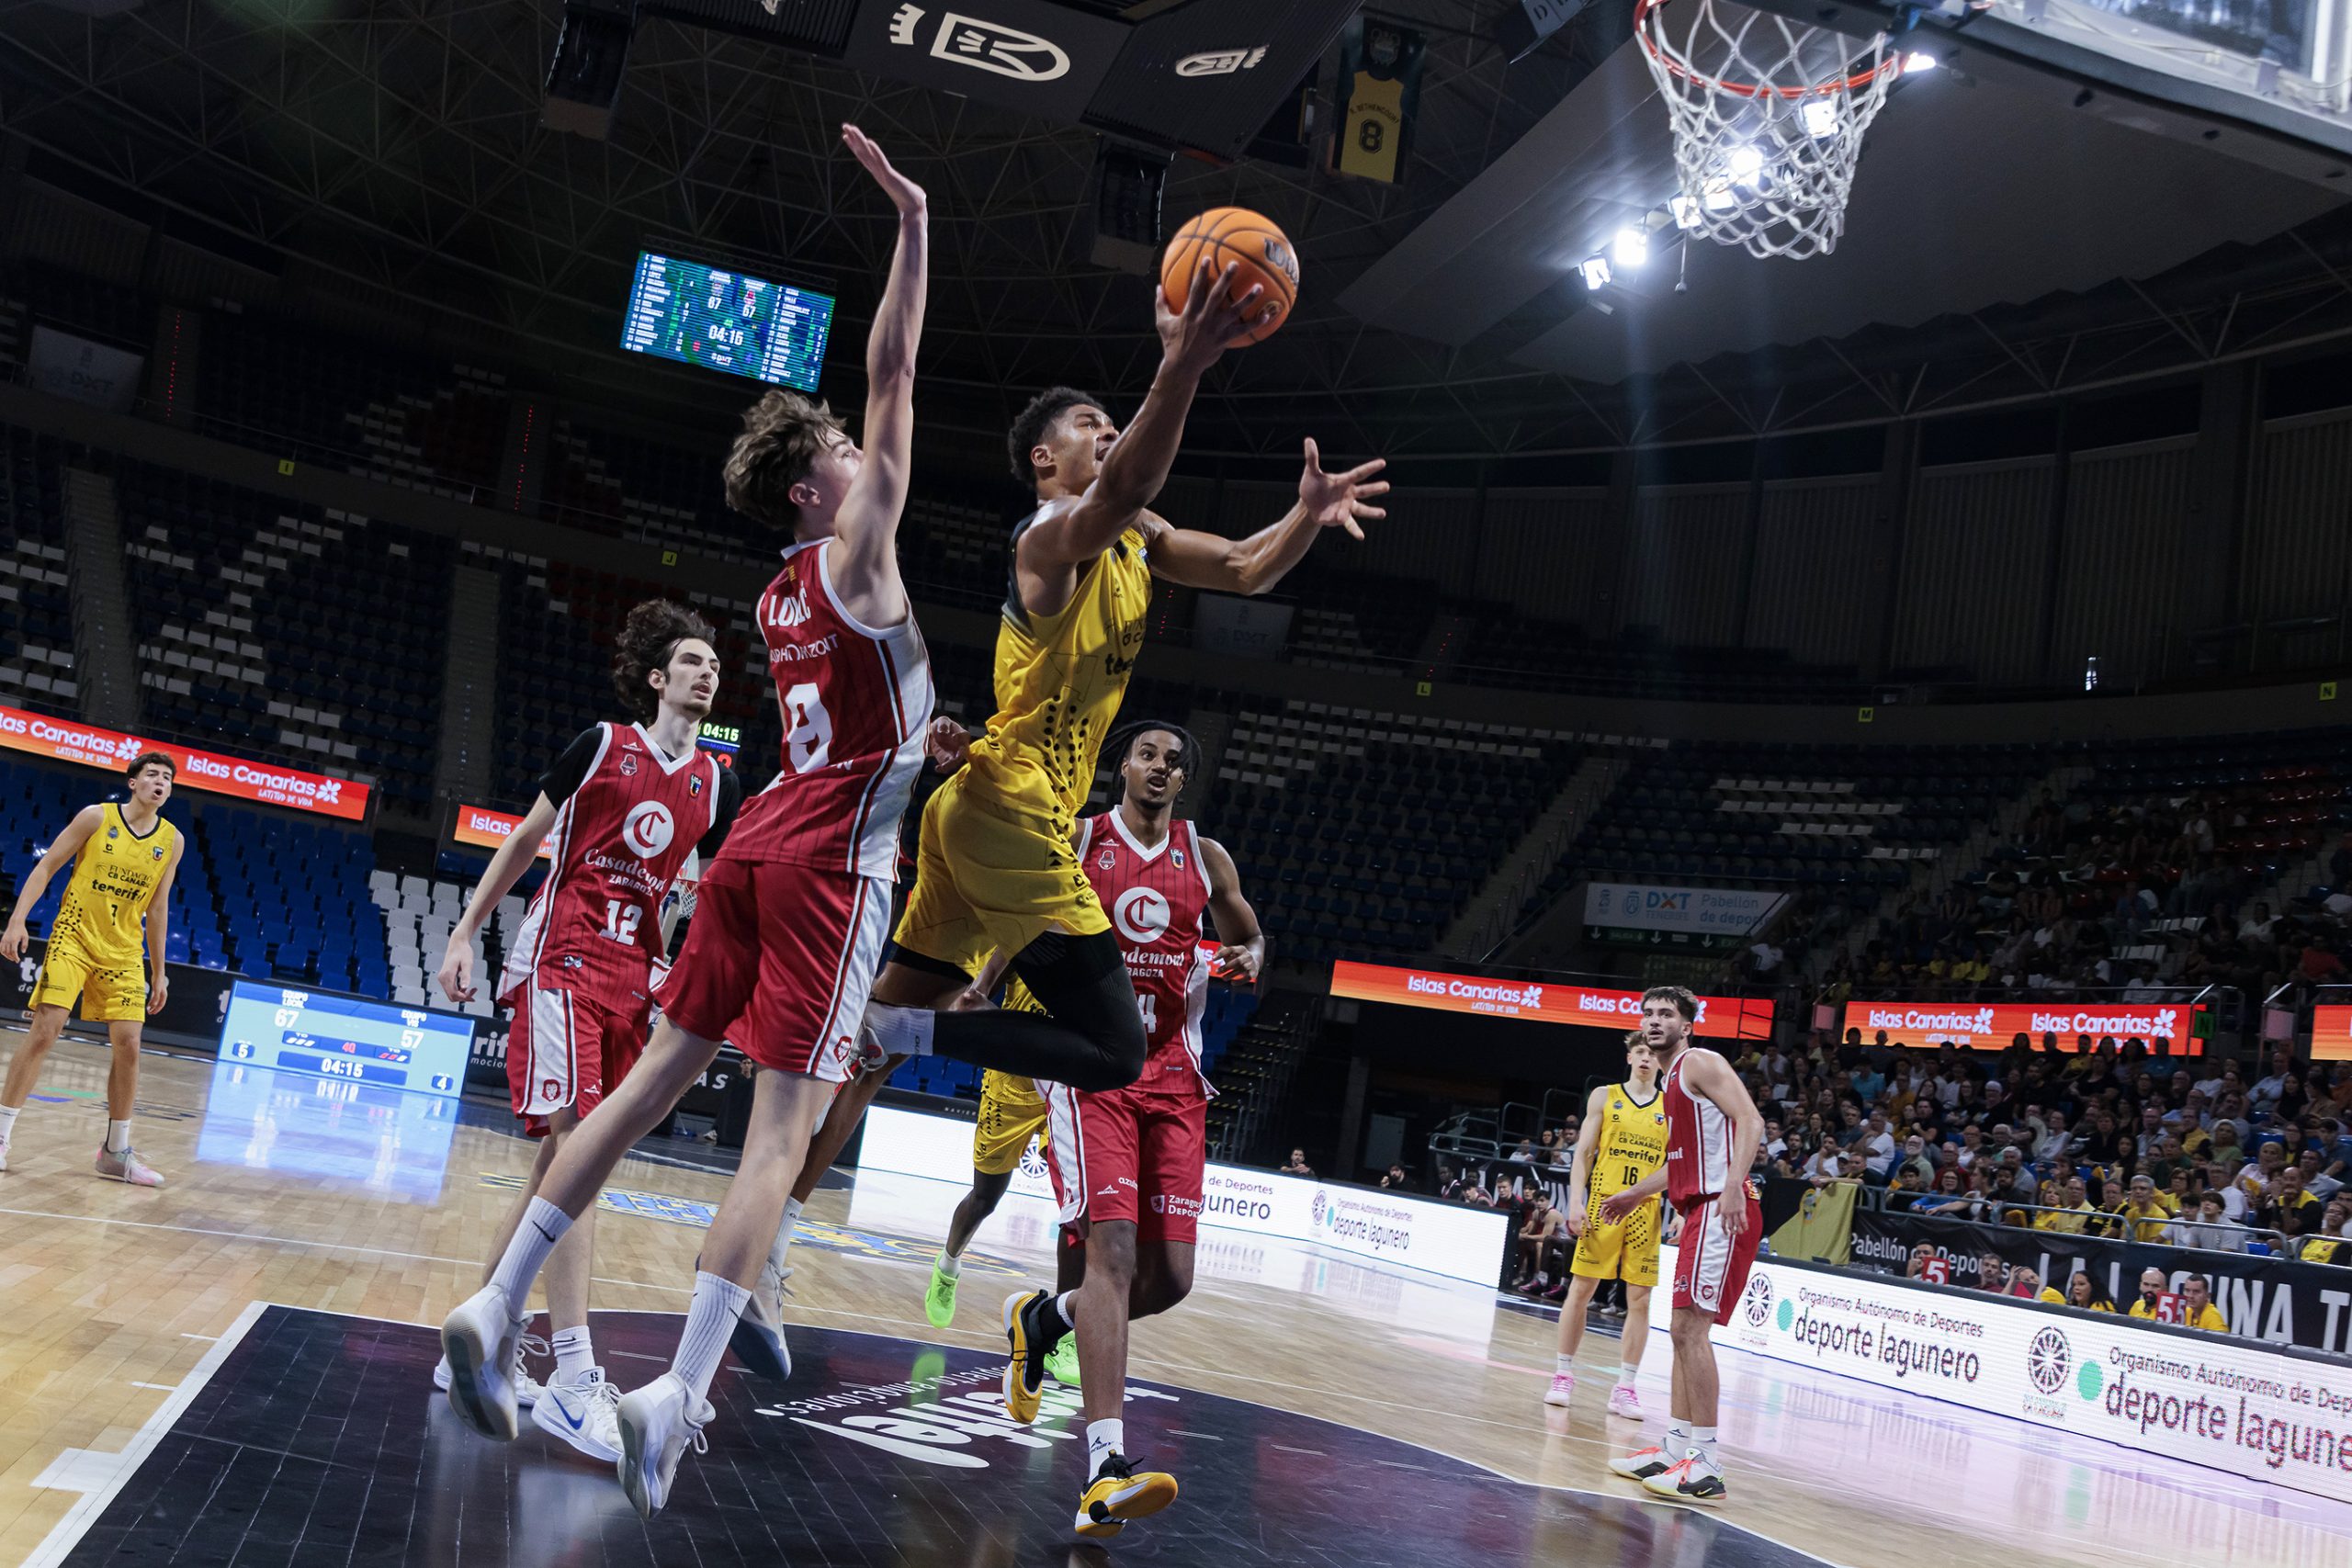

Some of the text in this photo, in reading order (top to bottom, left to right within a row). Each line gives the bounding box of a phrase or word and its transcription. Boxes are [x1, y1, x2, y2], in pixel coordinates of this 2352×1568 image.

[1359, 118, 1384, 154] 8
[30, 721, 115, 753] Canarias
[785, 682, 833, 774] 8
[187, 755, 316, 795] Islas Canarias
[298, 797, 313, 807] VIDA
[470, 813, 512, 836] Islas
[1646, 891, 1758, 909] DXT Pabellón
[599, 899, 643, 946] 12
[1700, 909, 1715, 922] de
[1408, 976, 1521, 1004] Islas Canarias
[1579, 994, 1615, 1012] Islas
[275, 1008, 300, 1028] 67
[1869, 1010, 1973, 1031] Islas Canarias
[2031, 1012, 2152, 1033] Islas Canarias
[401, 1029, 424, 1049] 57
[238, 1044, 248, 1058] 5
[321, 1058, 363, 1077] 04:15
[436, 1077, 447, 1090] 4
[1630, 1139, 1662, 1152] CANARIAS
[1208, 1176, 1273, 1195] de Deportes
[1622, 1166, 1638, 1186] 16
[1334, 1208, 1409, 1250] deporte lagunero
[1926, 1261, 1945, 1285] 5
[1799, 1287, 1984, 1337] Organismo Autónomo de Deportes
[2157, 1294, 2174, 1323] 5
[1795, 1307, 1980, 1382] deporte lagunero
[2109, 1346, 2191, 1380] Organismo
[2196, 1362, 2285, 1400] Autónomo
[2290, 1381, 2311, 1405] de
[2106, 1371, 2226, 1435] deporte
